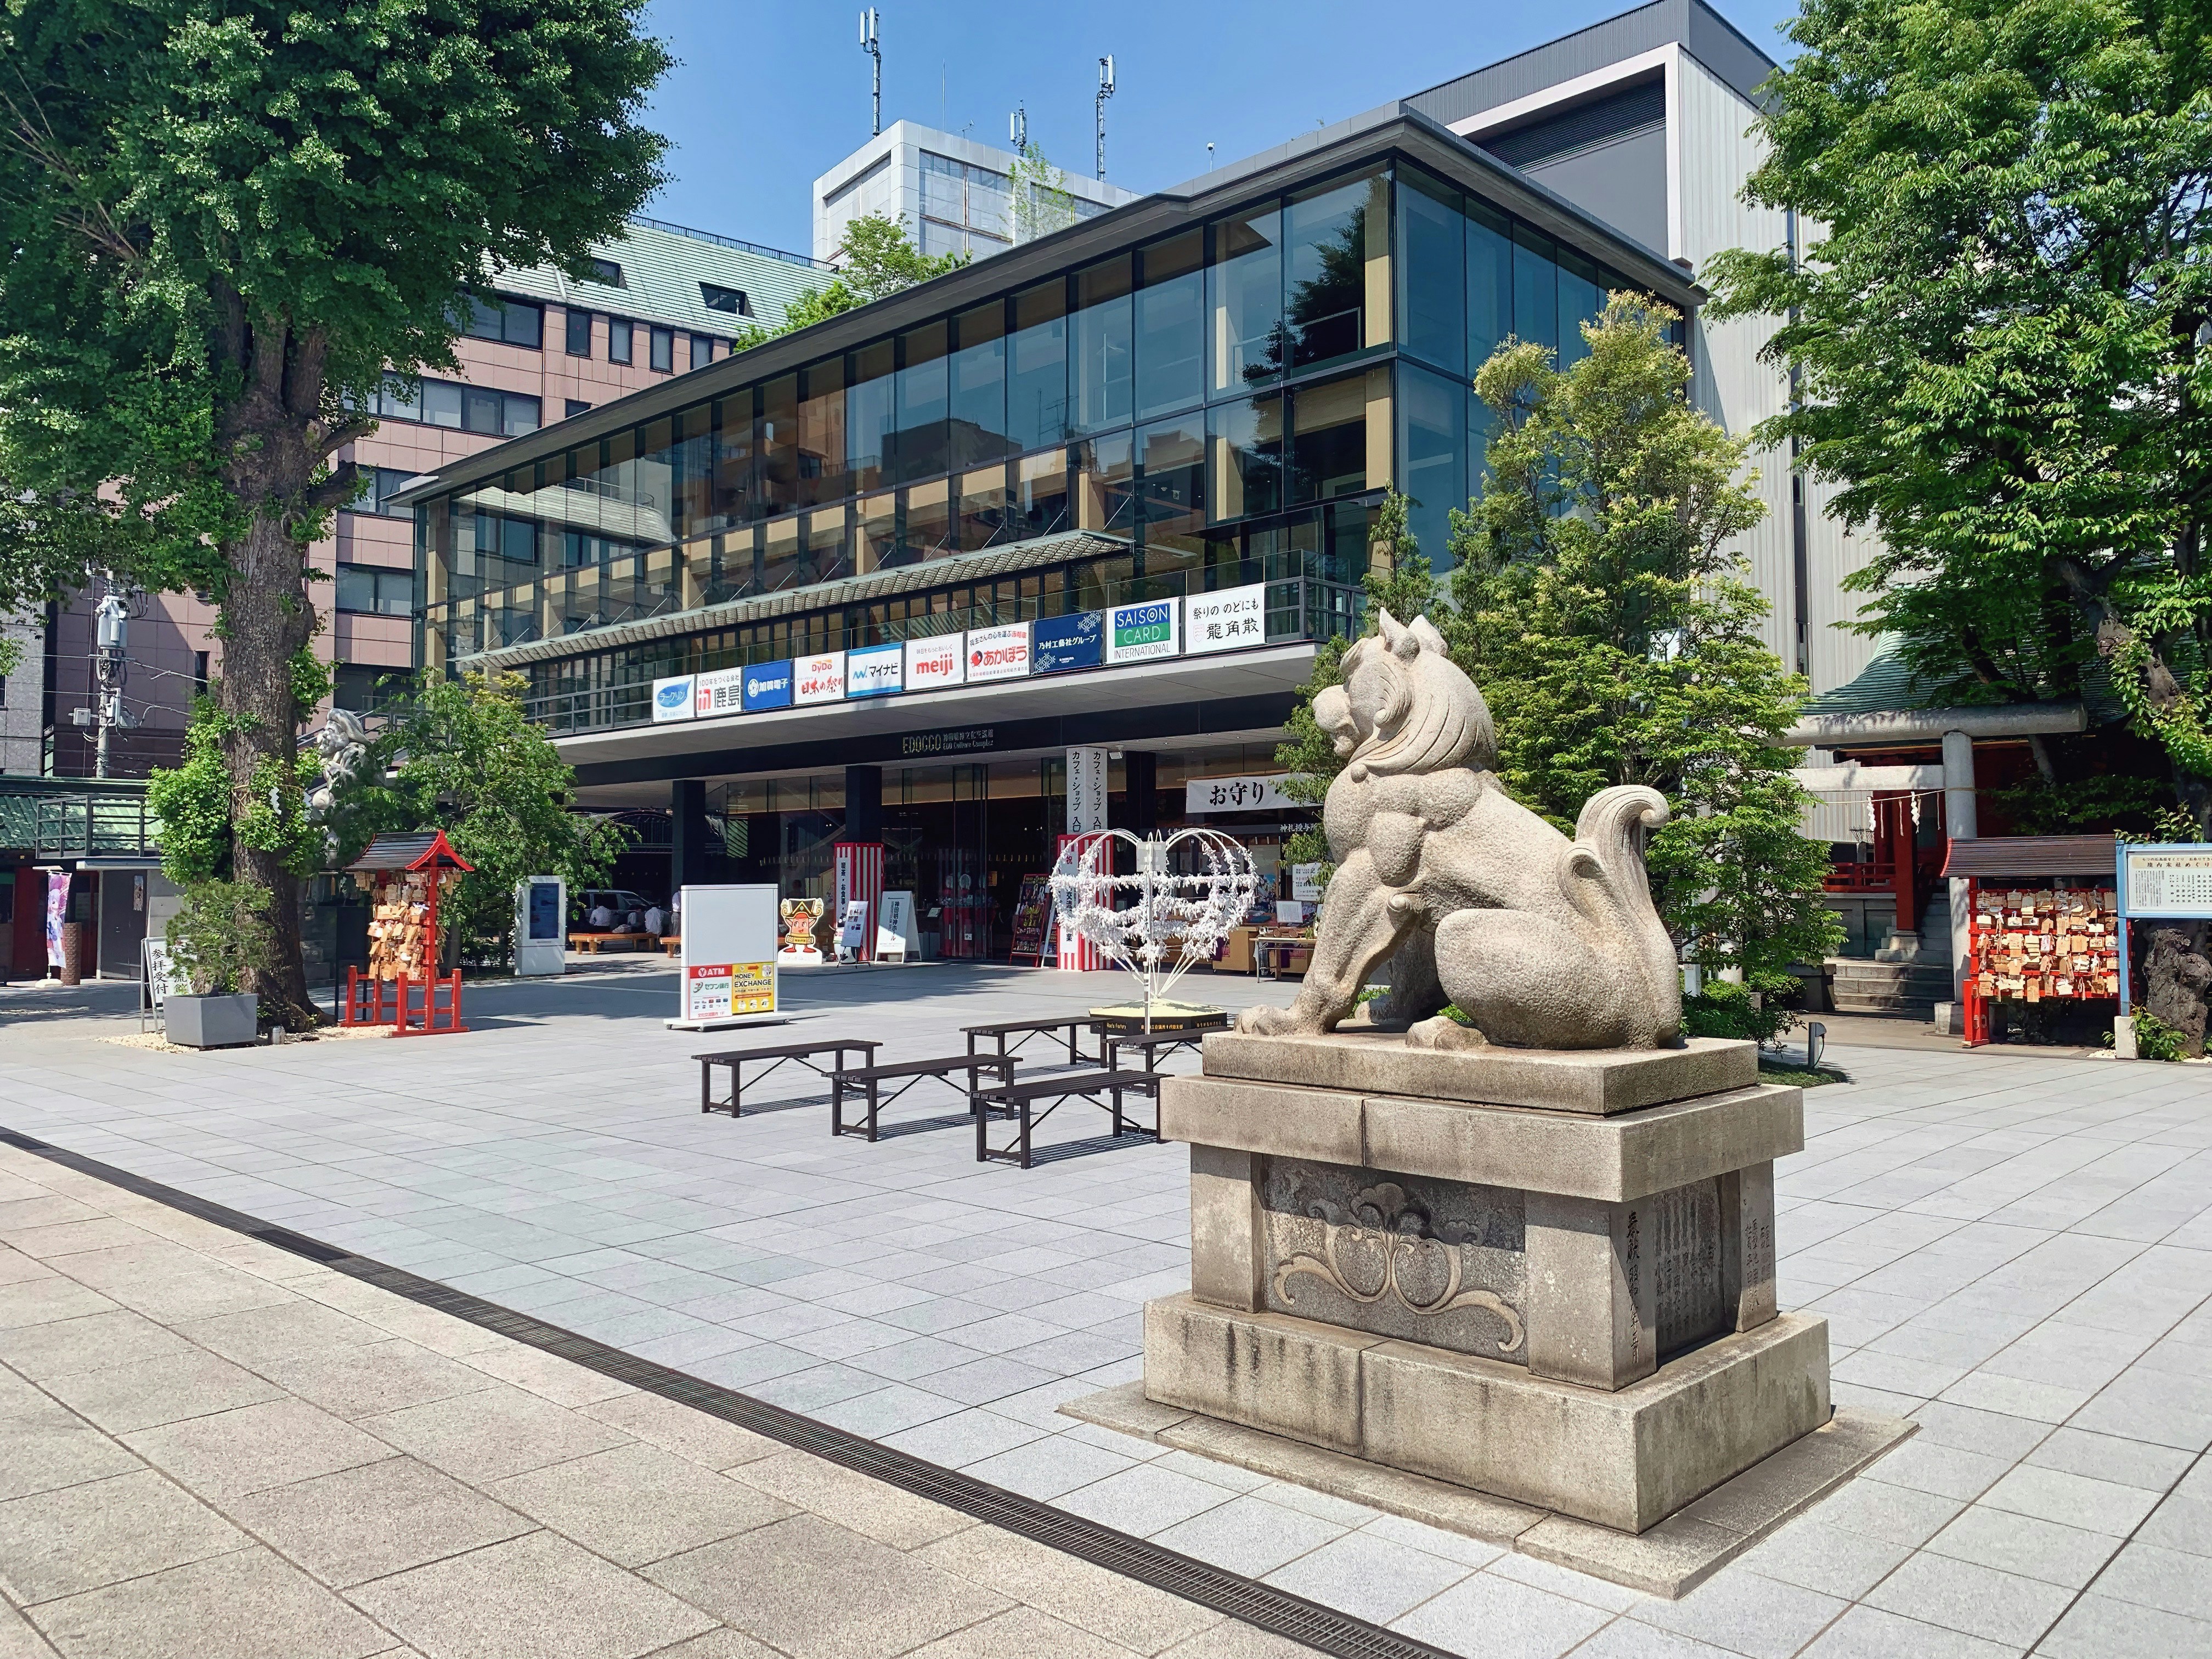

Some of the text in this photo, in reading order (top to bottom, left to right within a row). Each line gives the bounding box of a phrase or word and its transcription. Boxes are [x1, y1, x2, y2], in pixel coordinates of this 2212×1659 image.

[1117, 605, 1168, 627] SAISON
[1193, 598, 1259, 620] 祭りの のどにも
[1124, 625, 1161, 644] CARD
[1207, 617, 1259, 640] 龍角散
[916, 644, 952, 654] 明日をもっとおいしく
[983, 645, 1028, 666] あかぼう
[1114, 643, 1170, 659] INTERNATIONAL
[812, 663, 832, 673] DyDo
[869, 662, 898, 678] マイナビ
[916, 653, 953, 676] meiji
[699, 674, 740, 686] 100年をつくる会社
[802, 675, 843, 695] 日本の祭り
[714, 685, 740, 708] 鹿島
[902, 734, 941, 754] EDOCCO
[1072, 751, 1081, 832] カフェ・ショップ 入口
[152, 949, 168, 994] 参拝受付
[735, 979, 772, 988] EXCHANGE
